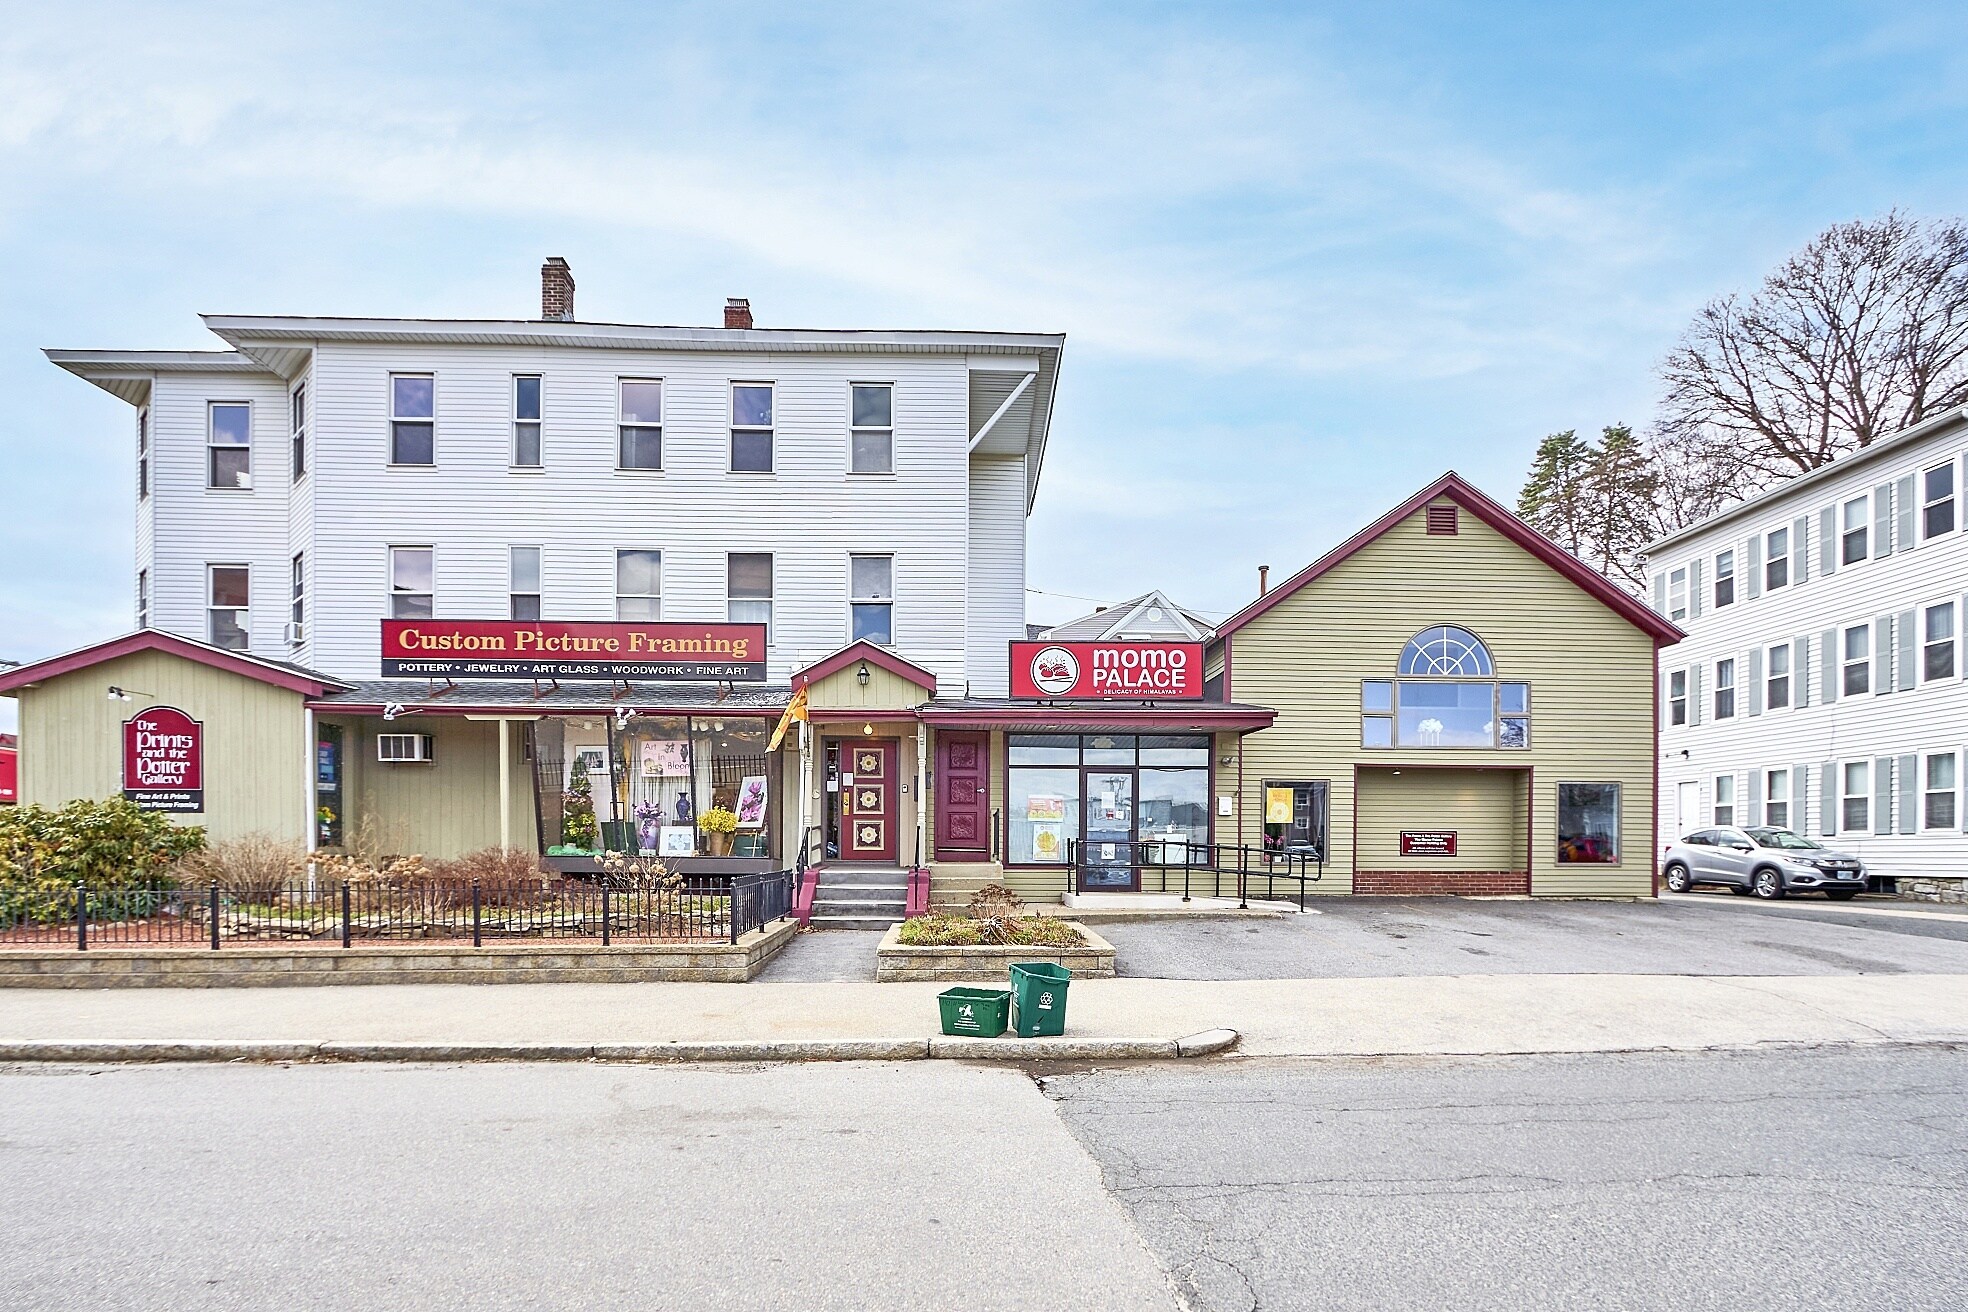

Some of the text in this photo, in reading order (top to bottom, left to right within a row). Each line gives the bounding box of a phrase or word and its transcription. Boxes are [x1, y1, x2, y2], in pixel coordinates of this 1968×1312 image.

[399, 629, 749, 659] Custom Picture Framing
[1093, 649, 1187, 669] momo
[398, 663, 749, 676] POTTERY JEWELRY ART GLASS WOODWORK FINE ART
[1093, 668, 1187, 688] PALACE
[136, 720, 158, 731] The
[136, 731, 193, 753] Prints
[644, 742, 657, 750] Art
[141, 748, 188, 759] and the
[136, 757, 191, 779] Potter
[141, 773, 183, 785] Gallery
